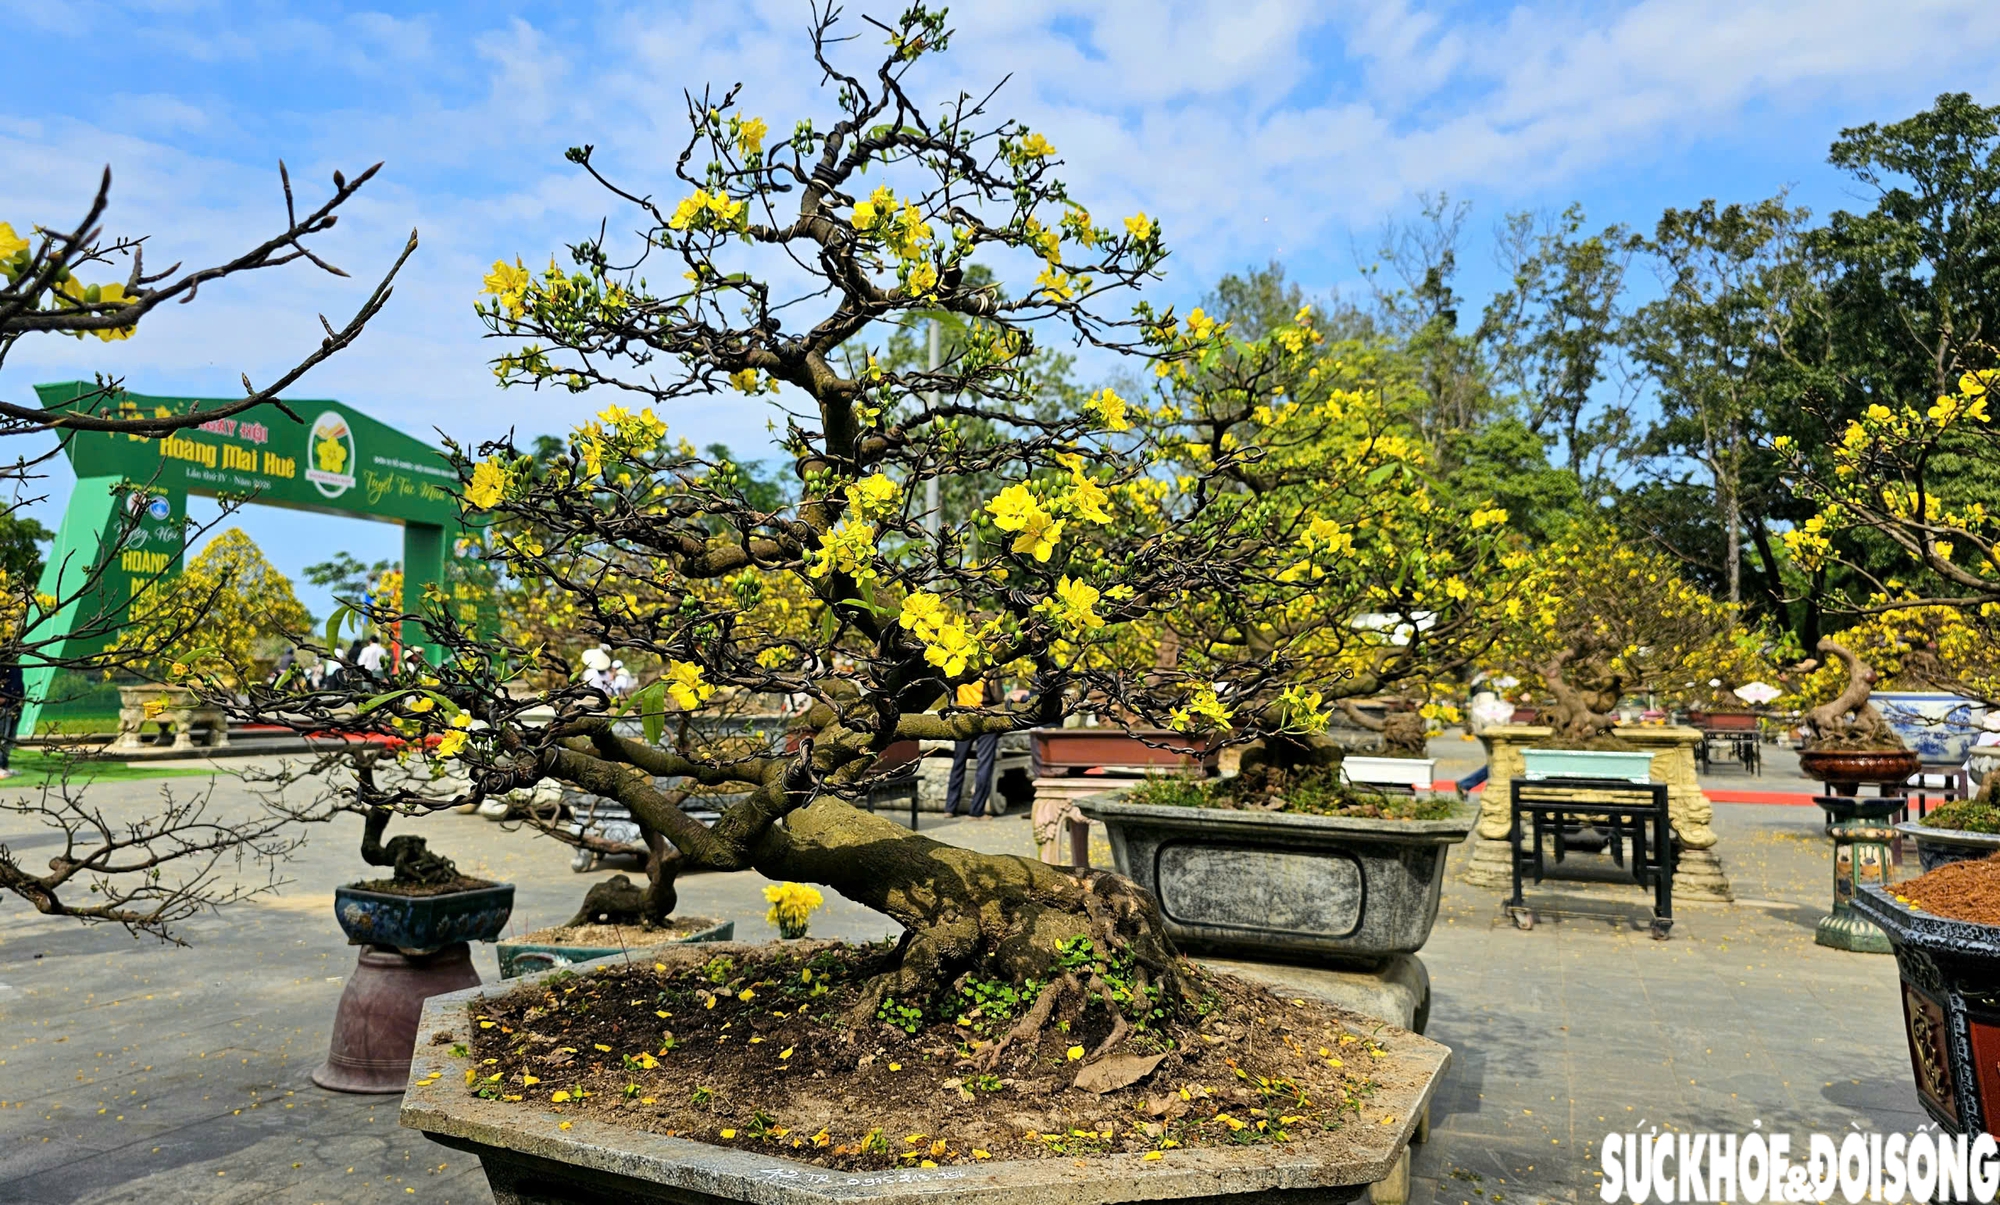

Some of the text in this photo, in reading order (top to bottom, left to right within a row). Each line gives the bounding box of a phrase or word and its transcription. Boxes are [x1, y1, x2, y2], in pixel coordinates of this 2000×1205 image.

[240, 422, 268, 445] HỘI
[160, 431, 217, 469] Hoàng
[222, 443, 258, 472] Mai
